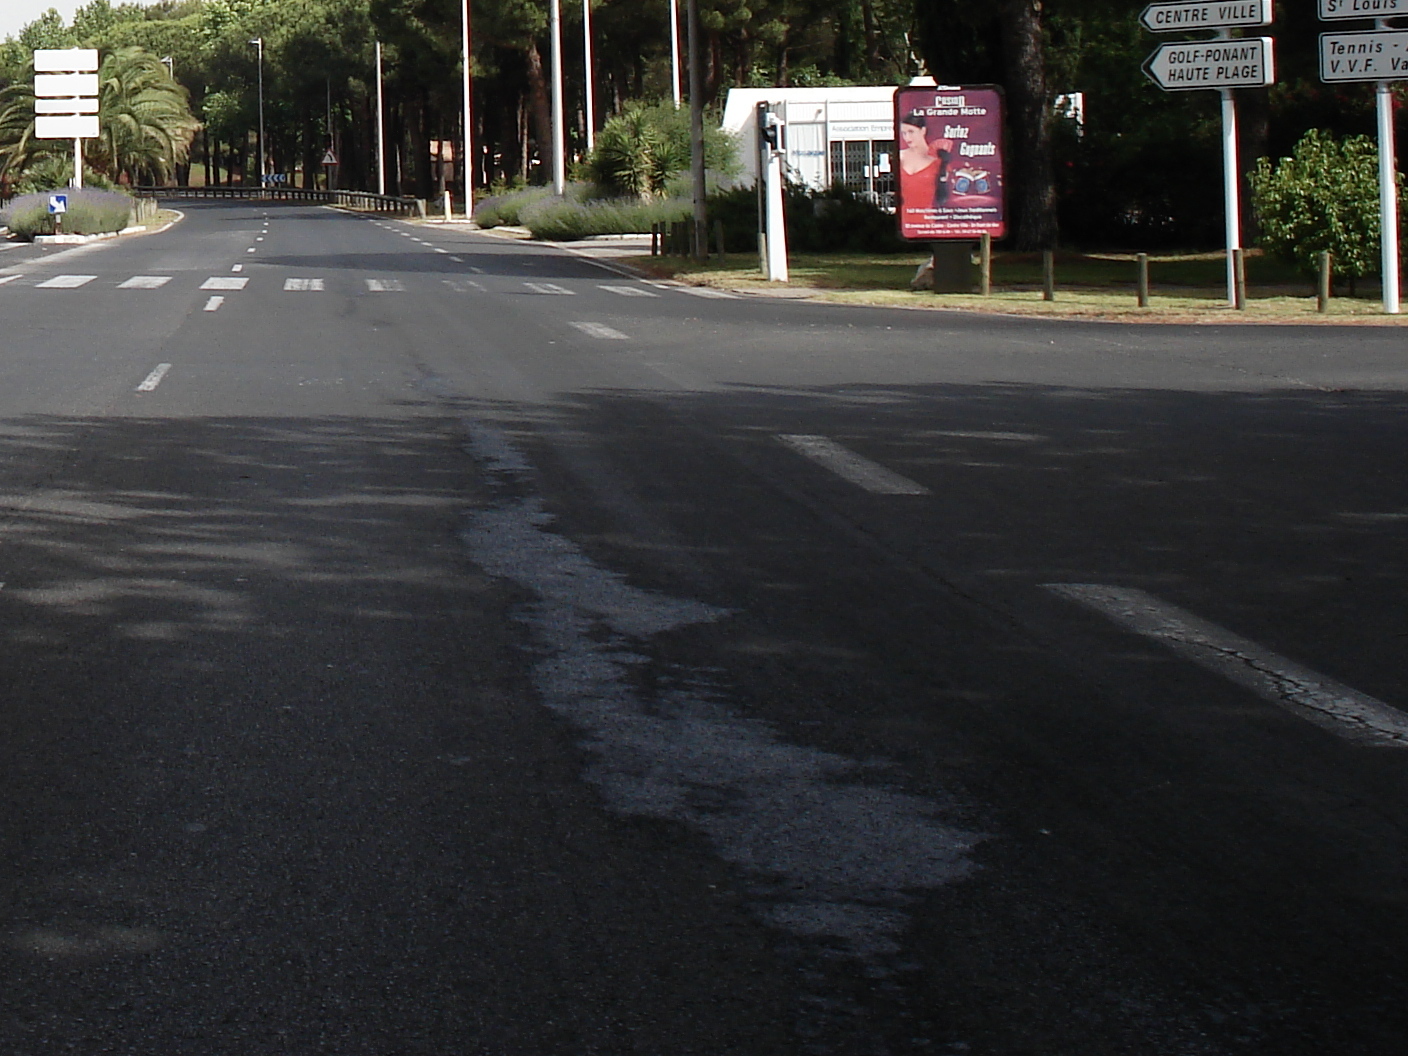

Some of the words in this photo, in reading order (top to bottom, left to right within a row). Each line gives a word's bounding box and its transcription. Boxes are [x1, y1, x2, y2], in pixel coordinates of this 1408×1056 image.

[1155, 7, 1209, 24] CENTRE
[1218, 4, 1257, 20] VILLE
[1330, 39, 1383, 55] Tennis
[1168, 47, 1258, 64] GOLF-PONANT
[1168, 67, 1210, 82] HAUTE
[1216, 65, 1258, 80] PLAGE
[1331, 58, 1378, 73] V.V.F.
[913, 108, 925, 117] La
[926, 108, 959, 117] Grande
[960, 107, 987, 116] Motte
